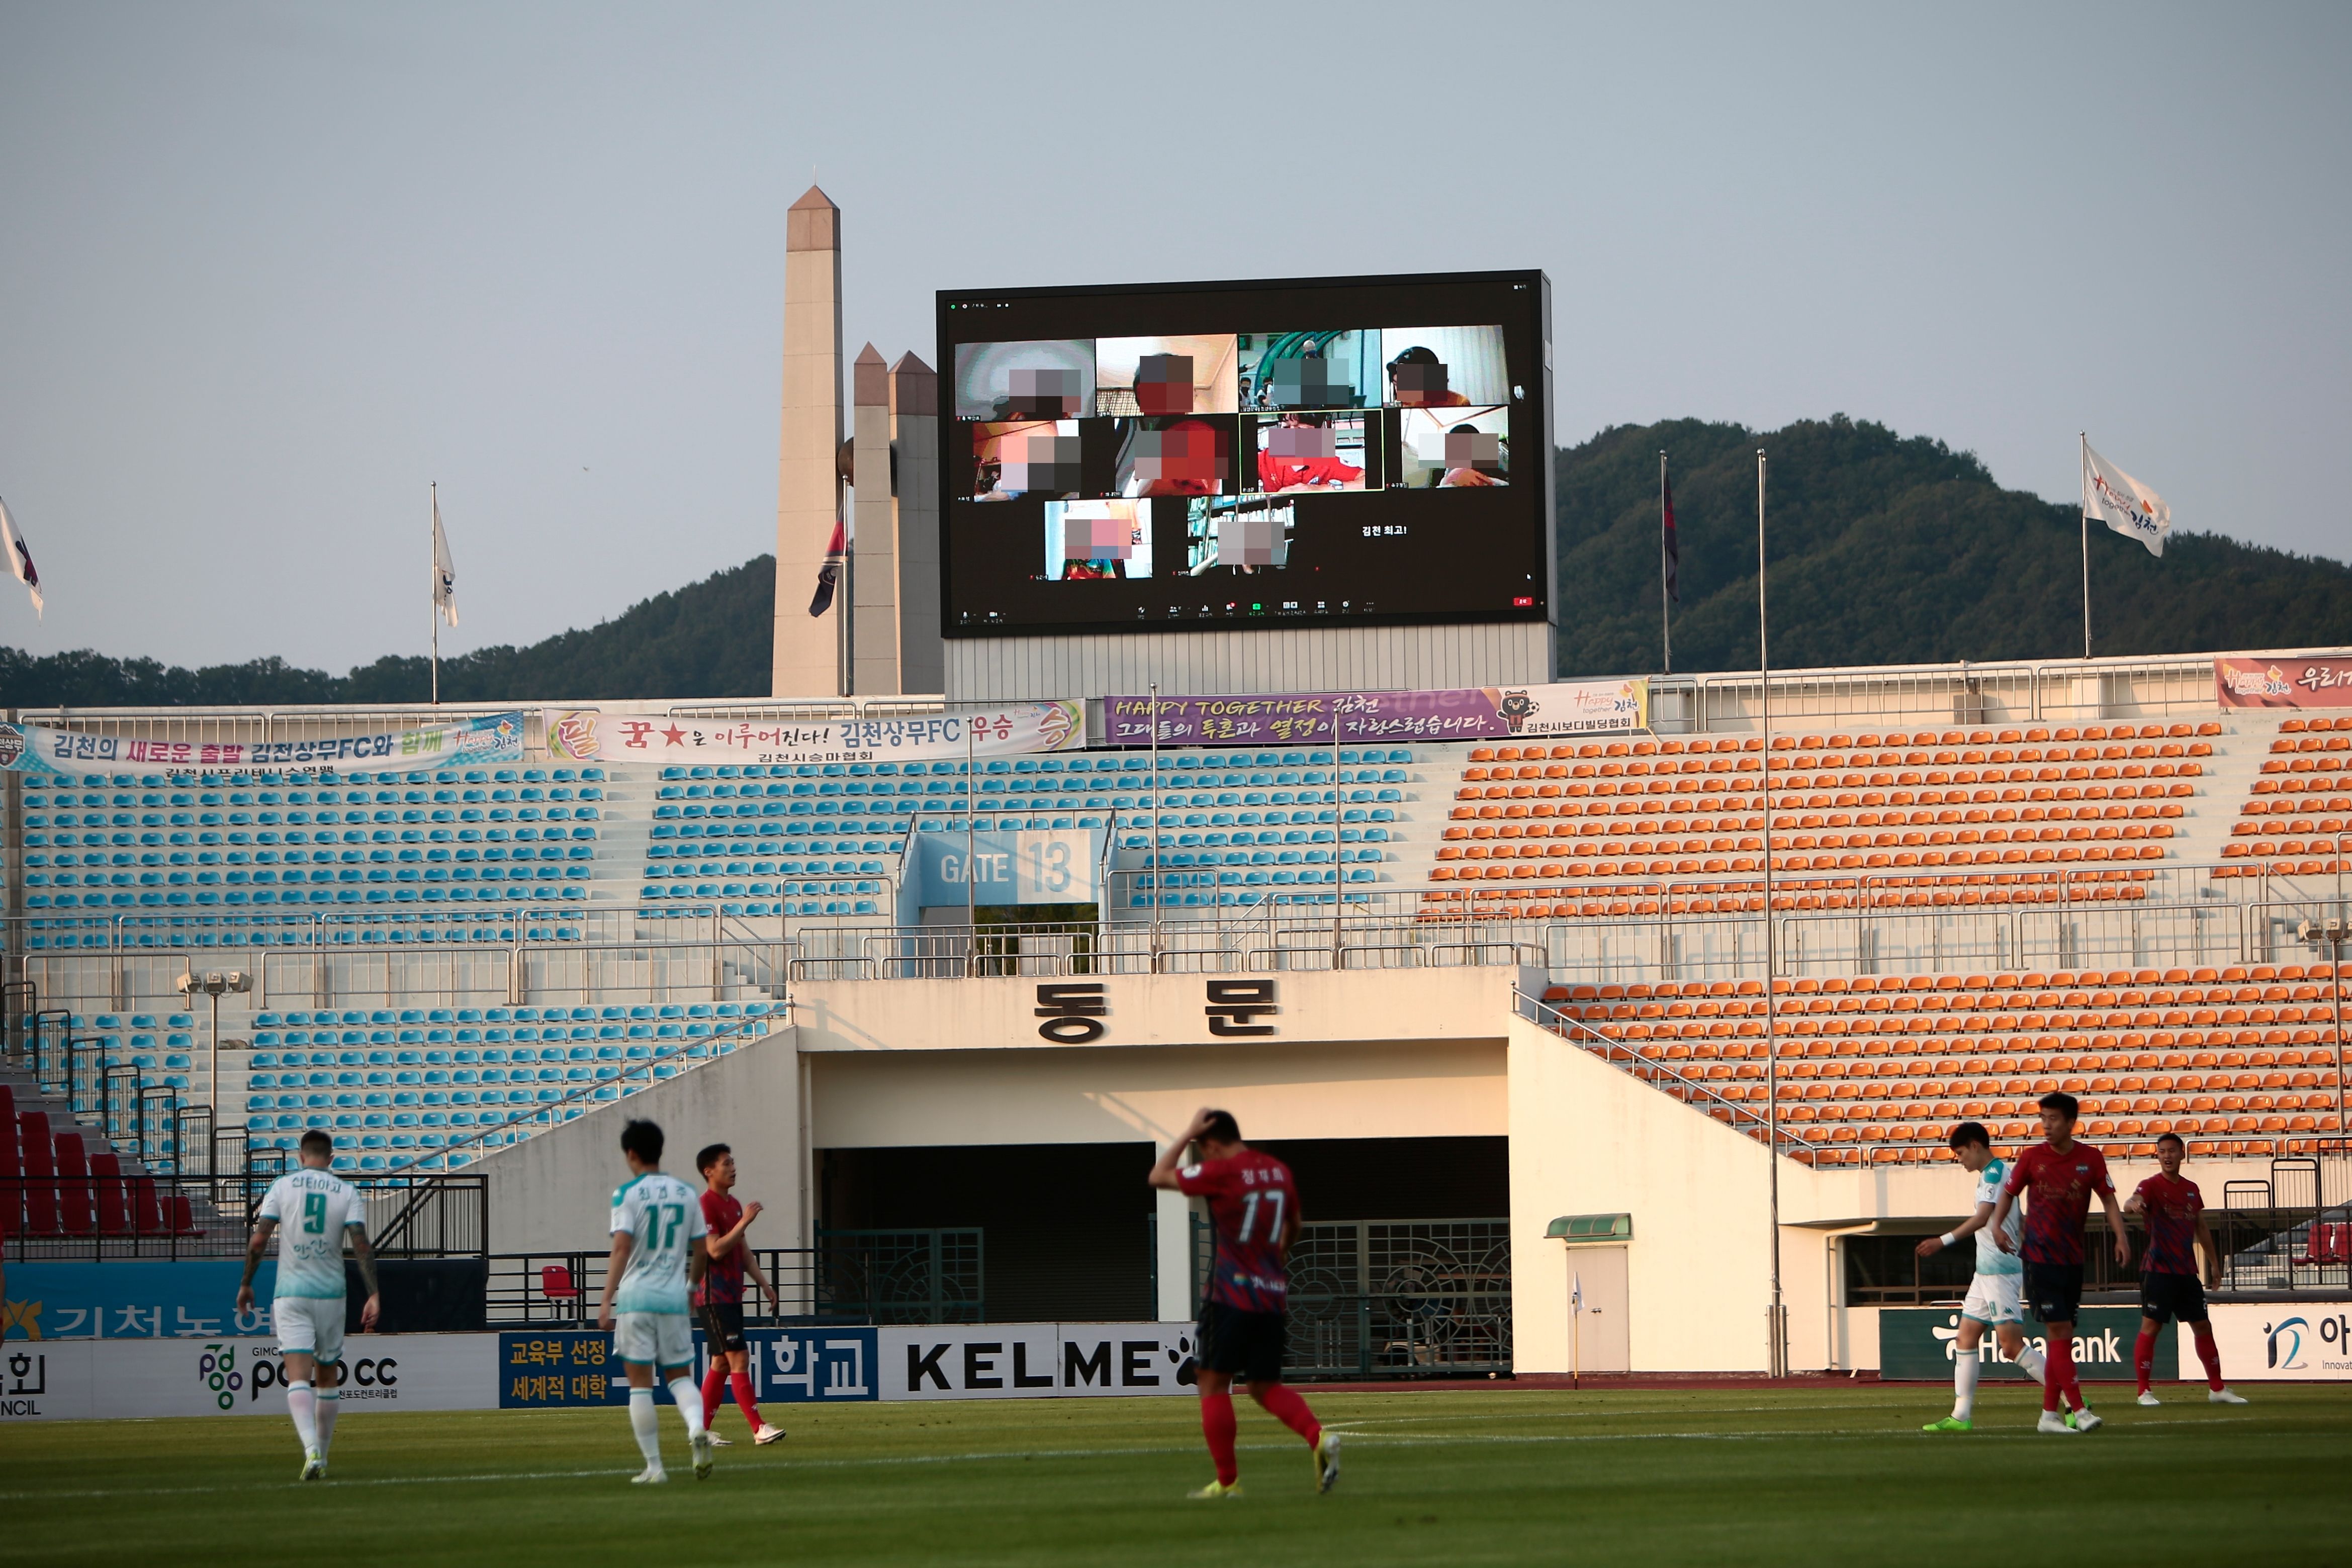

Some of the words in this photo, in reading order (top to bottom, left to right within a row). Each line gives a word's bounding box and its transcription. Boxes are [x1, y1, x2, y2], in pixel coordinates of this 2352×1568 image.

[1362, 525, 1381, 536] 김천
[1384, 525, 1407, 535] 최고!
[2130, 510, 2158, 535] 김천
[1574, 689, 1613, 708] Happy
[2265, 682, 2291, 695] 김천
[1115, 701, 1188, 716] HAPPY
[1195, 699, 1325, 716] TOGETHER
[1332, 694, 1380, 714] 김천
[1582, 706, 1612, 714] together
[1614, 698, 1638, 713] 김천
[561, 717, 600, 756] 필
[618, 721, 656, 749] 꿈
[715, 722, 830, 750] 이루어진다!
[840, 718, 961, 749] 김천상무FC
[971, 714, 1014, 742] 우승
[1116, 720, 1192, 741] 그대들의
[1201, 717, 1261, 740] 투혼과
[1270, 717, 1335, 740] 열정이
[1345, 714, 1495, 735] 자랑스럽습니다.
[1527, 717, 1631, 733] 김천시보디빌딩협회
[54, 734, 119, 762] 김천의
[126, 741, 192, 764] 새로운
[200, 744, 244, 764] 출발
[251, 734, 394, 764] 김천상무FC와
[402, 729, 444, 754] 함께
[493, 736, 520, 750] 김천
[758, 751, 873, 763] 김천시승마협회
[941, 853, 1009, 883] GATE
[1028, 841, 1072, 893] 13
[1034, 983, 1104, 1044] 동
[1205, 979, 1277, 1036] 문
[304, 1193, 327, 1234] 9
[1238, 1190, 1285, 1243] 17
[644, 1204, 685, 1250] 17
[510, 1340, 564, 1366] 교육부
[570, 1340, 606, 1365] 선정
[907, 1340, 1160, 1392] KELME
[0, 1352, 45, 1395] 회
[339, 1389, 398, 1400] 천포도컨트리클럽
[511, 1375, 565, 1401] 세계적
[572, 1374, 607, 1400] 대학
[0, 1400, 41, 1416] NCIL
